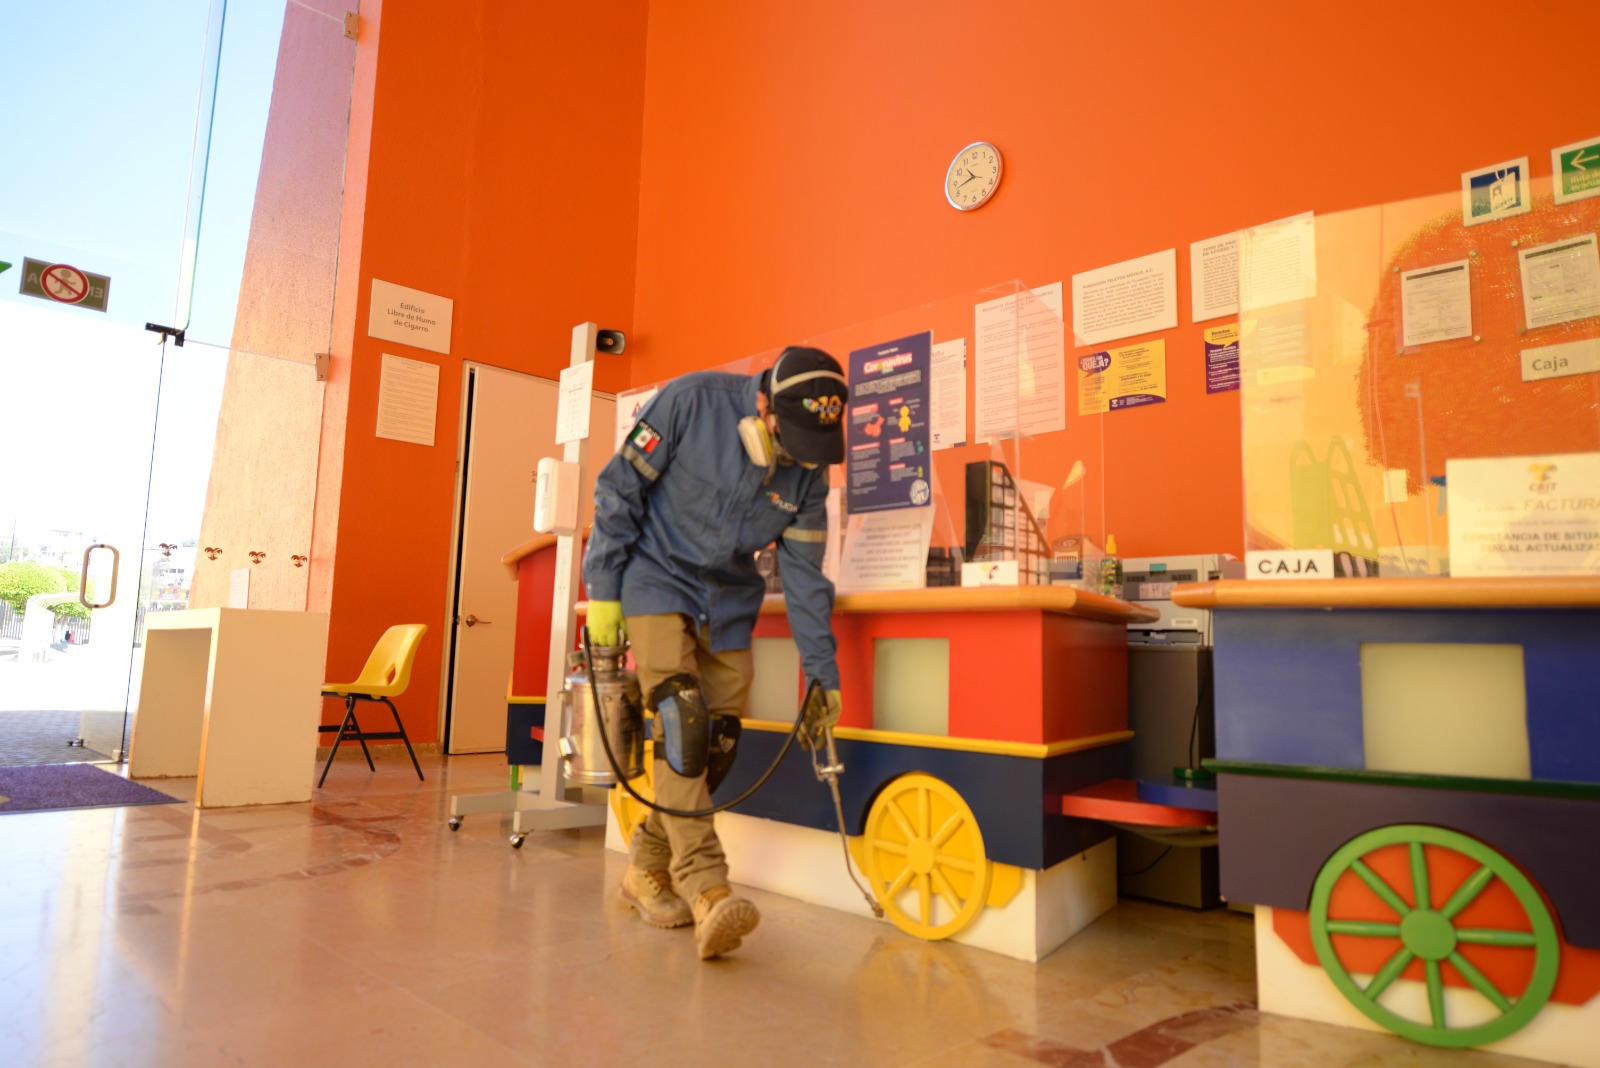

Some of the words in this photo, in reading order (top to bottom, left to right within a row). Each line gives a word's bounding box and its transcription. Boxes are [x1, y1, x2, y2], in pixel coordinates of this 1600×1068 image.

[1210, 246, 1230, 254] ACCESO
[400, 302, 425, 314] Edificio
[387, 308, 405, 318] Libre
[416, 315, 436, 326] Humo
[403, 321, 429, 333] Cigarro
[1082, 358, 1109, 371] QUEJA?
[1531, 356, 1569, 372] Caja
[1529, 483, 1557, 492] CRIT
[1463, 532, 1541, 541] CONSTANCIA
[1544, 532, 1560, 541] DE
[1257, 559, 1319, 574] CAJA
